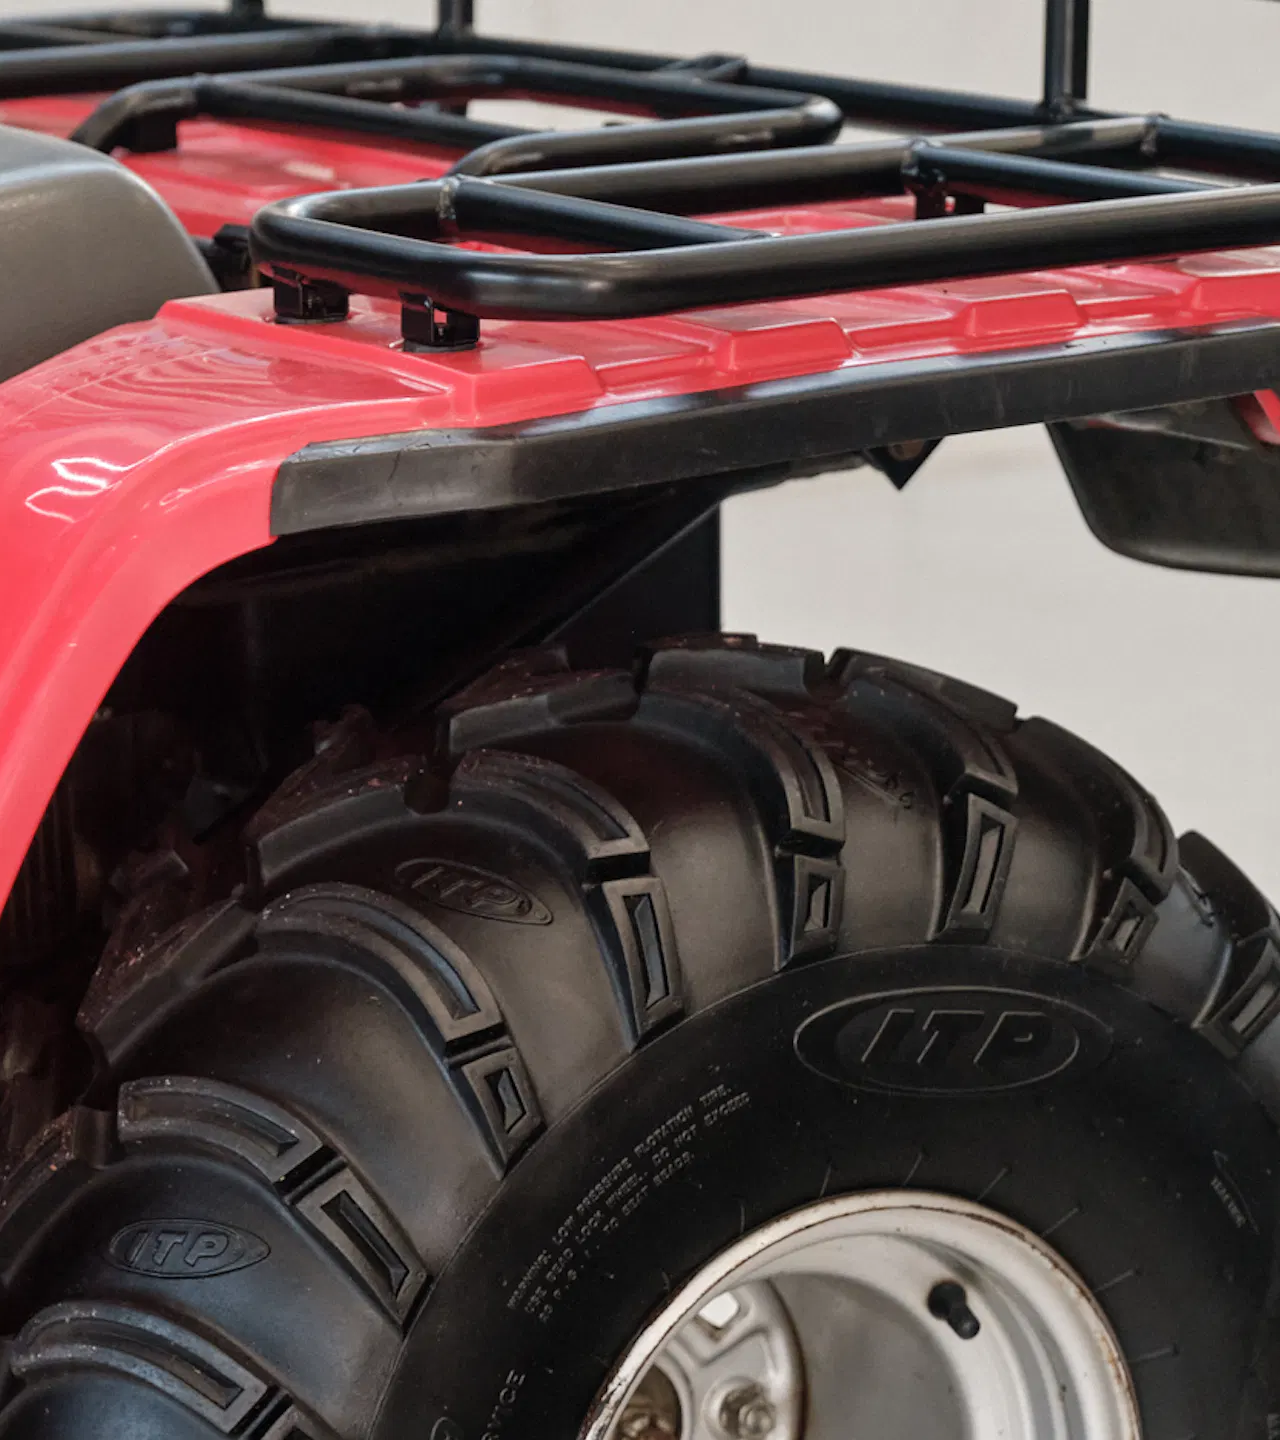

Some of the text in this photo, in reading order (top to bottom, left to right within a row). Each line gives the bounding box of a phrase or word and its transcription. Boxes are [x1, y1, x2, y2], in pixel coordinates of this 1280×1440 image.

[860, 1009, 1053, 1063] ITP
[673, 1123, 697, 1148] NOT
[576, 1157, 632, 1216] PRESSURE
